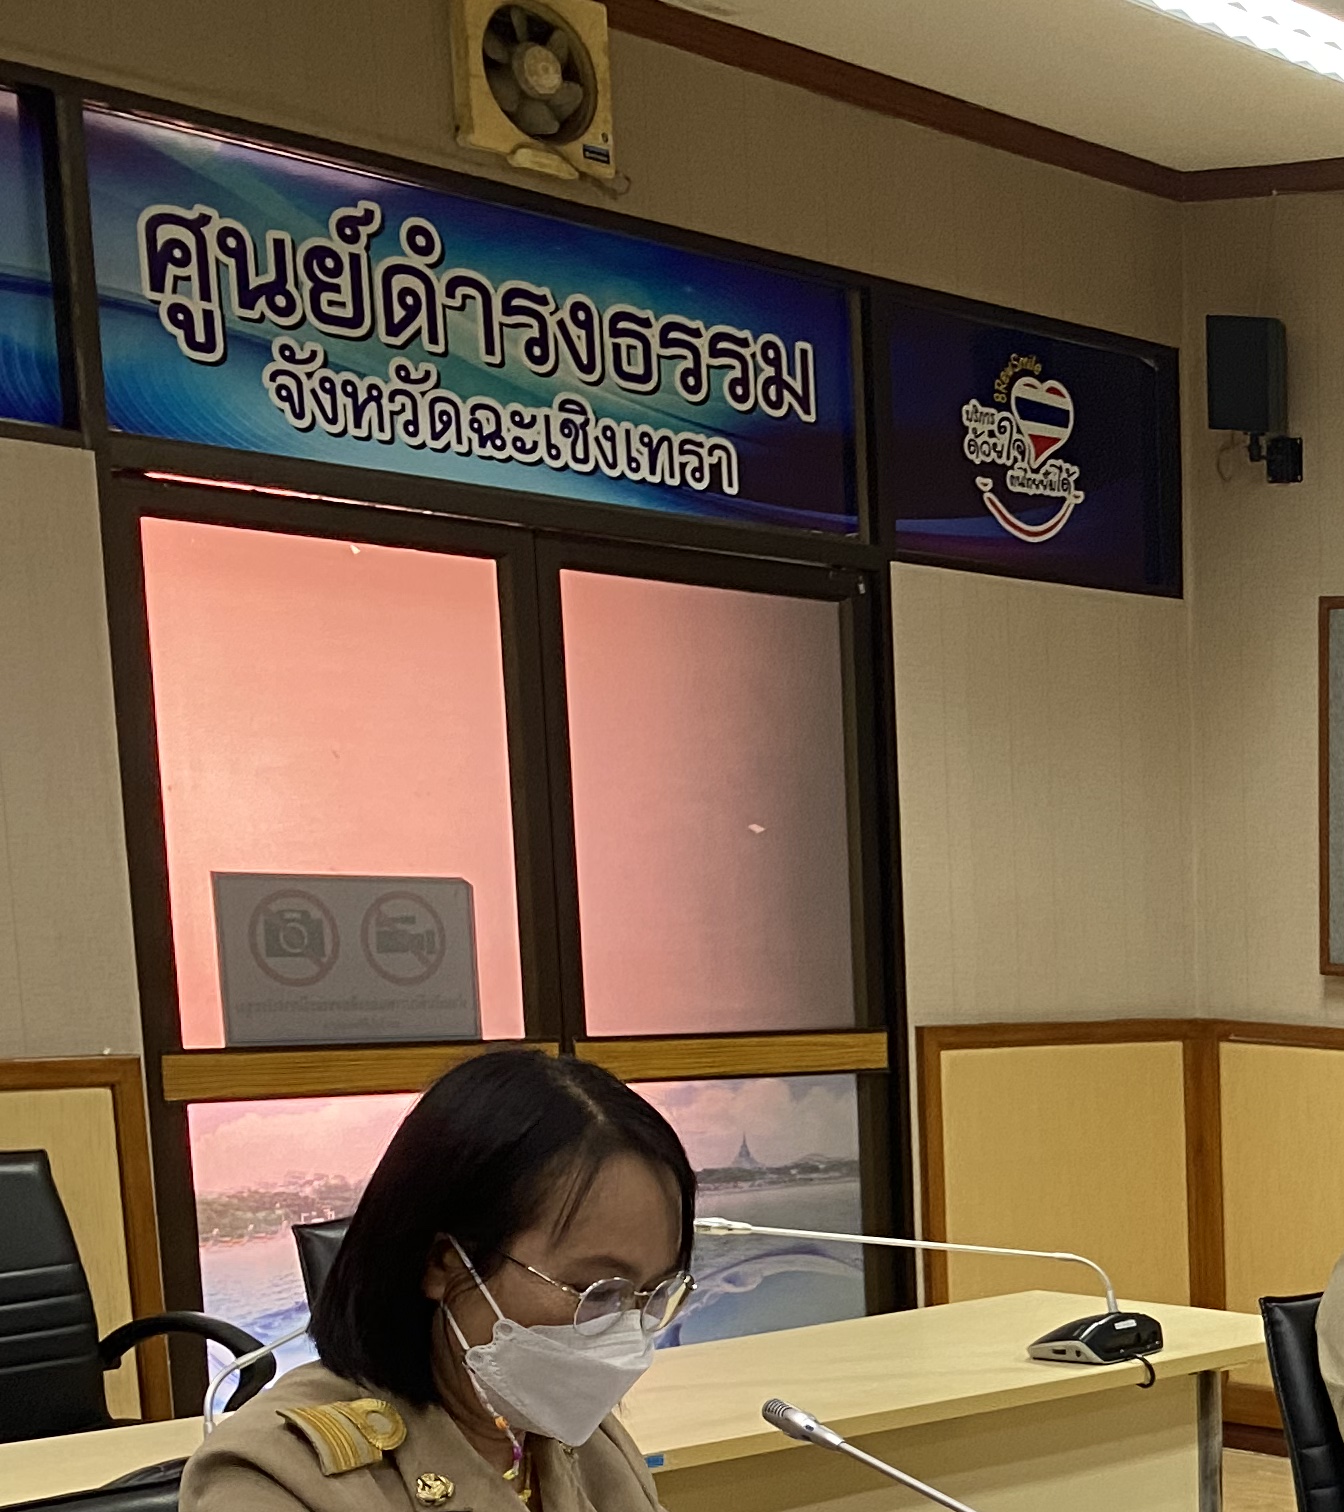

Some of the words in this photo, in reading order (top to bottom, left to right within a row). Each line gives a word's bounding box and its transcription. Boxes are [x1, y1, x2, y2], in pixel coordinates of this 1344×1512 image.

[143, 202, 816, 421] ศูนย์ดำรงธรรม
[268, 340, 738, 492] จังหวัดฉะเชิงเทรา
